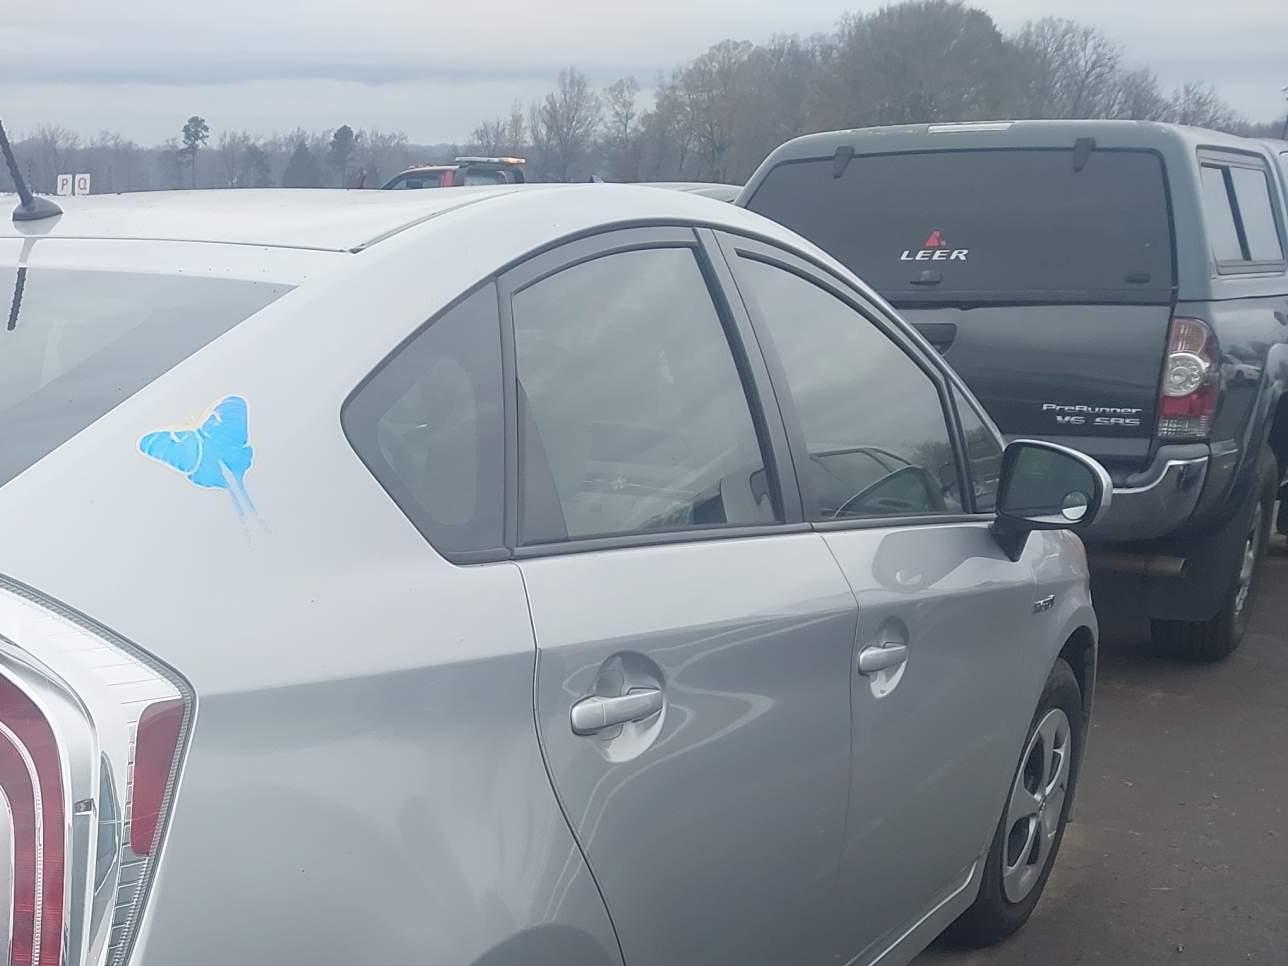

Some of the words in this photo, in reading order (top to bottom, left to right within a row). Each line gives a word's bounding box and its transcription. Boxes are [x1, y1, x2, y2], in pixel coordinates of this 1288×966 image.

[61, 177, 69, 191] P
[77, 177, 88, 191] Q
[900, 248, 969, 261] LEER
[1042, 403, 1143, 415] PreRunner
[1056, 415, 1086, 425] V6
